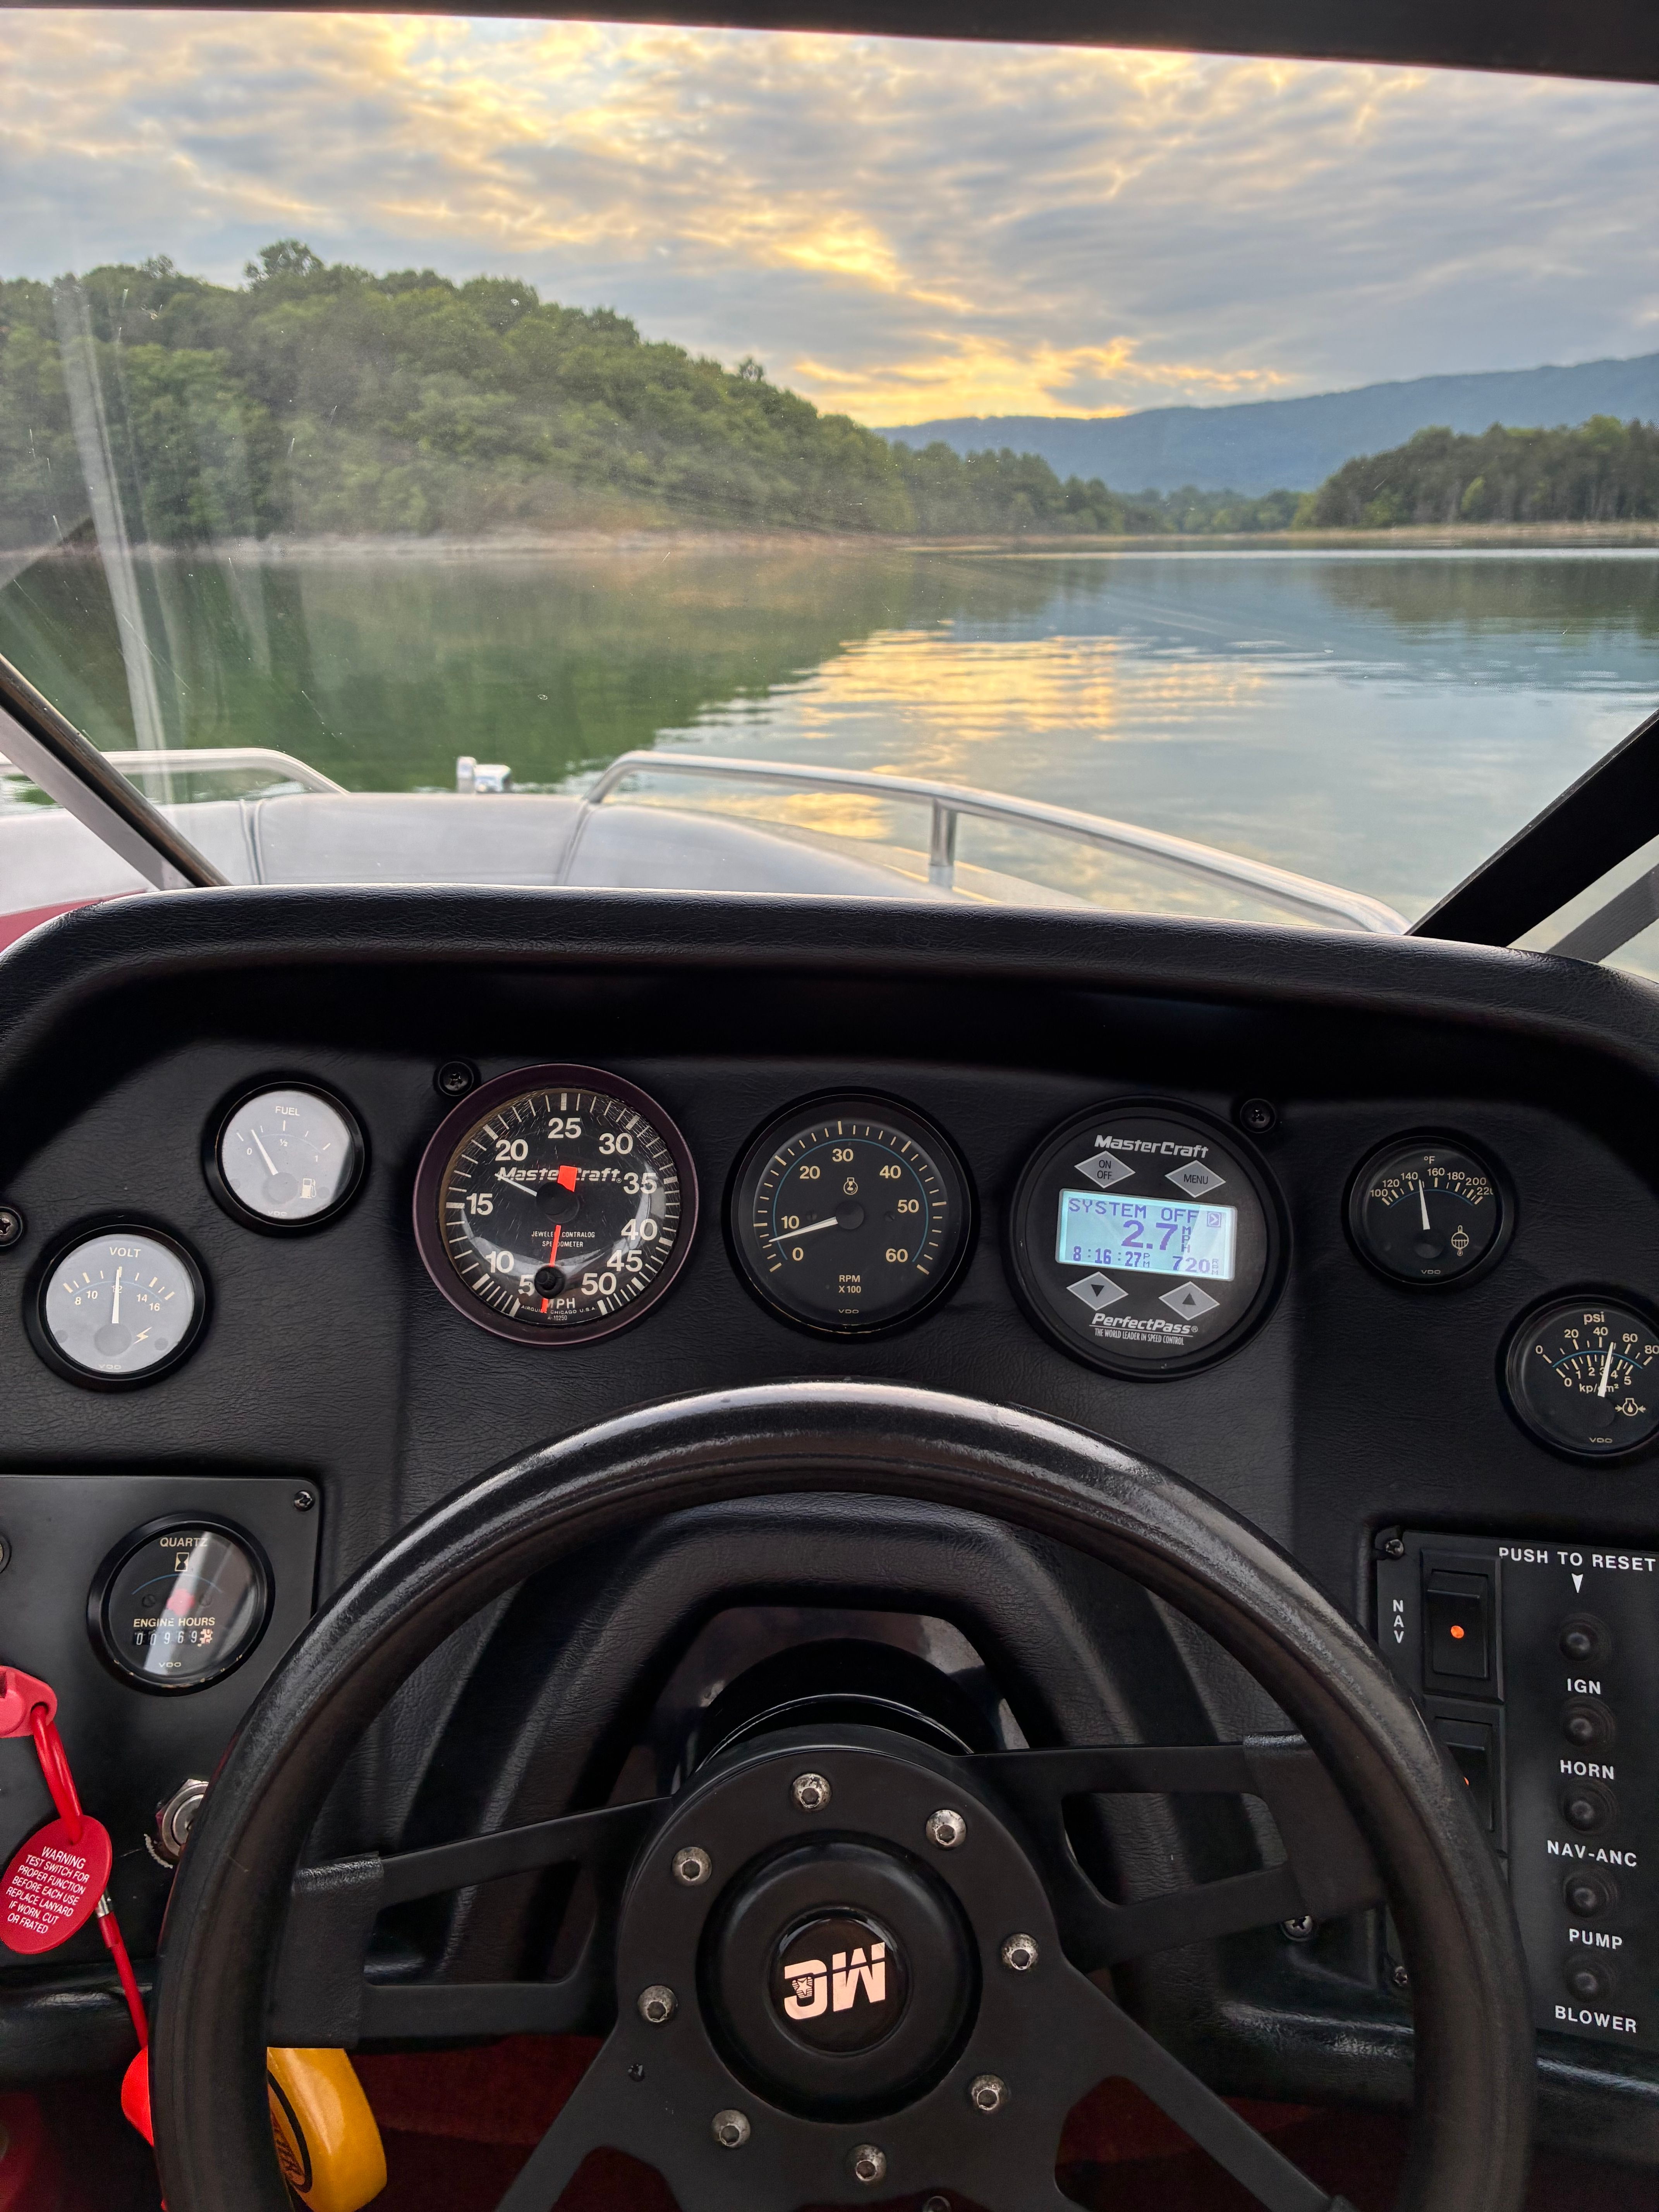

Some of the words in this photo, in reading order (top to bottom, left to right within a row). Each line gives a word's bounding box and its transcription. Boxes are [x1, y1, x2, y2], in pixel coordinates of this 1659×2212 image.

[275, 1106, 300, 1116] FUEL
[548, 1118, 581, 1139] 25
[495, 1140, 528, 1161] 20
[599, 1133, 633, 1154] 30
[1094, 1135, 1209, 1158] MasterCraft
[832, 1148, 854, 1162] 30
[1099, 1159, 1111, 1169] ON
[800, 1166, 821, 1179] 20
[879, 1165, 901, 1179] 40
[1097, 1170, 1112, 1180] OFF
[1400, 1172, 1418, 1180] 140
[1427, 1168, 1445, 1176] 160
[1447, 1172, 1465, 1180] 180
[623, 1173, 656, 1194] 35
[1183, 1174, 1209, 1185] MENU
[1382, 1179, 1400, 1188] 120
[1465, 1177, 1486, 1185] 200
[1370, 1189, 1388, 1197] 100
[466, 1194, 493, 1215] 15
[897, 1199, 919, 1213] 50
[1069, 1198, 1147, 1219] SYSTEM
[1161, 1207, 1199, 1223] OFF
[621, 1219, 658, 1240] 40
[781, 1216, 799, 1229] 10
[1121, 1219, 1178, 1250] 2.7
[1181, 1226, 1192, 1253] MPH
[109, 1247, 141, 1258] VOLT
[792, 1247, 804, 1261] 0
[886, 1249, 908, 1262] 60
[486, 1251, 514, 1273] 10
[606, 1250, 643, 1271] 45
[1173, 1255, 1210, 1273] 720
[518, 1274, 535, 1296] 5
[581, 1273, 617, 1295] 50
[839, 1274, 860, 1283] RPM
[75, 1297, 81, 1305] 8
[86, 1290, 98, 1299] 10
[137, 1293, 147, 1302] 14
[149, 1302, 160, 1312] 16
[1583, 1311, 1605, 1325] psi
[1095, 1328, 1104, 1337] THE
[1104, 1329, 1121, 1338] WORLD
[1123, 1331, 1140, 1341] LEADER
[1141, 1333, 1147, 1341] IN
[1147, 1334, 1162, 1343] SPEED
[1163, 1335, 1184, 1345] CONTROL
[1564, 1329, 1579, 1338] 20
[1593, 1327, 1608, 1336] 40
[1623, 1333, 1638, 1343] 60
[1535, 1345, 1543, 1354] 0
[1645, 1345, 1659, 1354] 80
[1575, 1370, 1581, 1379] 1
[1588, 1367, 1595, 1376] 2
[1611, 1370, 1618, 1379] 4
[1564, 1378, 1572, 1387] 0
[1624, 1376, 1632, 1386] 5
[160, 1537, 208, 1547] QUARTZ
[1499, 1547, 1548, 1564] PUSH
[1557, 1552, 1583, 1566] TO
[1592, 1554, 1656, 1572] RESET
[133, 1618, 175, 1627] ENGINE
[178, 1617, 215, 1626] HOURS
[1393, 1599, 1405, 1644] NAV
[1567, 1678, 1601, 1695] IGN
[1560, 1759, 1614, 1780] HORN
[41, 1846, 86, 1869] WARNING
[1547, 1840, 1637, 1867] NAV-ANC
[26, 1854, 45, 1867] TEST
[43, 1861, 74, 1878] SWITCH
[72, 1870, 90, 1883] FOR
[17, 1865, 48, 1882] PROPER
[47, 1875, 86, 1895] FUNCTION
[12, 1875, 43, 1893] BEFORE
[41, 1886, 64, 1900] EACH
[62, 1893, 80, 1906] USE
[6, 1886, 40, 1905] REPLACE
[39, 1898, 74, 1917] LANYARD
[7, 1913, 20, 1924] OR
[9, 1900, 18, 1909] IF
[42, 1912, 60, 1925] CUT
[1569, 1928, 1623, 1950] PUMP
[1554, 2005, 1637, 2033] BLOWER
